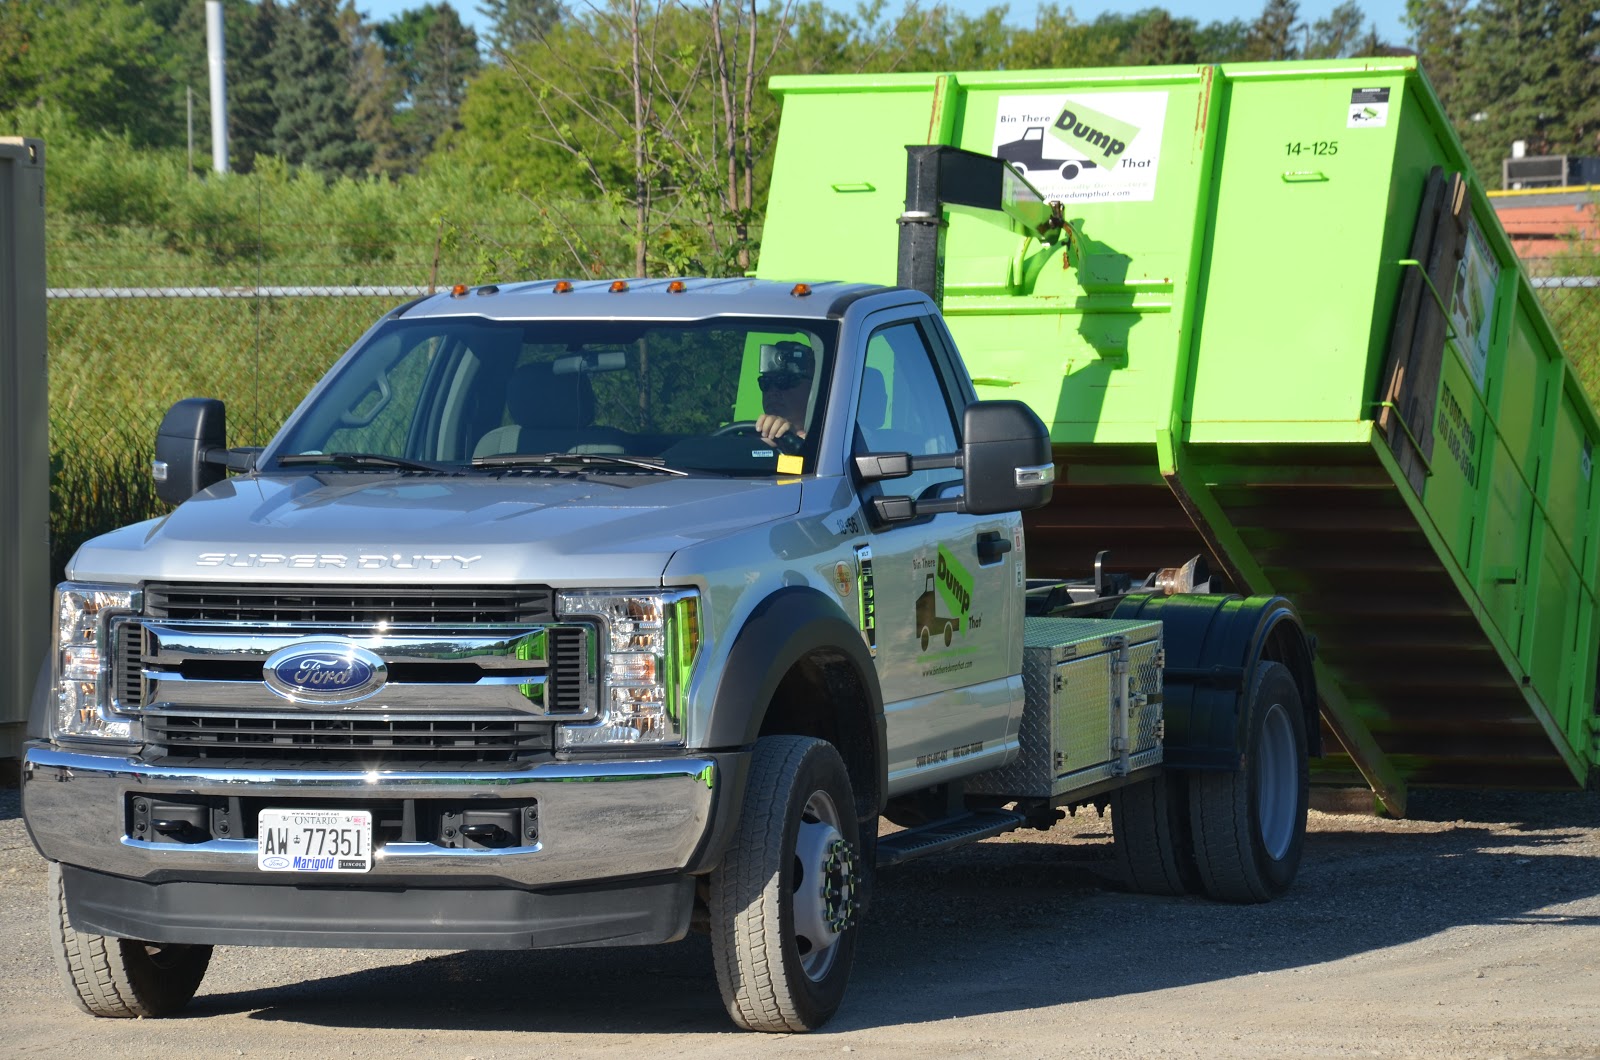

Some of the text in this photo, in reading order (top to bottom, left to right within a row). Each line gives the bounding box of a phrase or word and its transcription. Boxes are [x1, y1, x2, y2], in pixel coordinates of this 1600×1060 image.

[1000, 115, 1017, 123] Bin
[1054, 109, 1126, 158] Dump
[1285, 141, 1338, 156] 14-125
[1121, 158, 1151, 168] That
[196, 553, 482, 569] SUPER DUTY
[922, 558, 936, 568] There
[937, 551, 970, 615] Dump
[969, 615, 982, 629] That
[294, 658, 354, 686] Ford
[293, 856, 335, 870] Marigold
